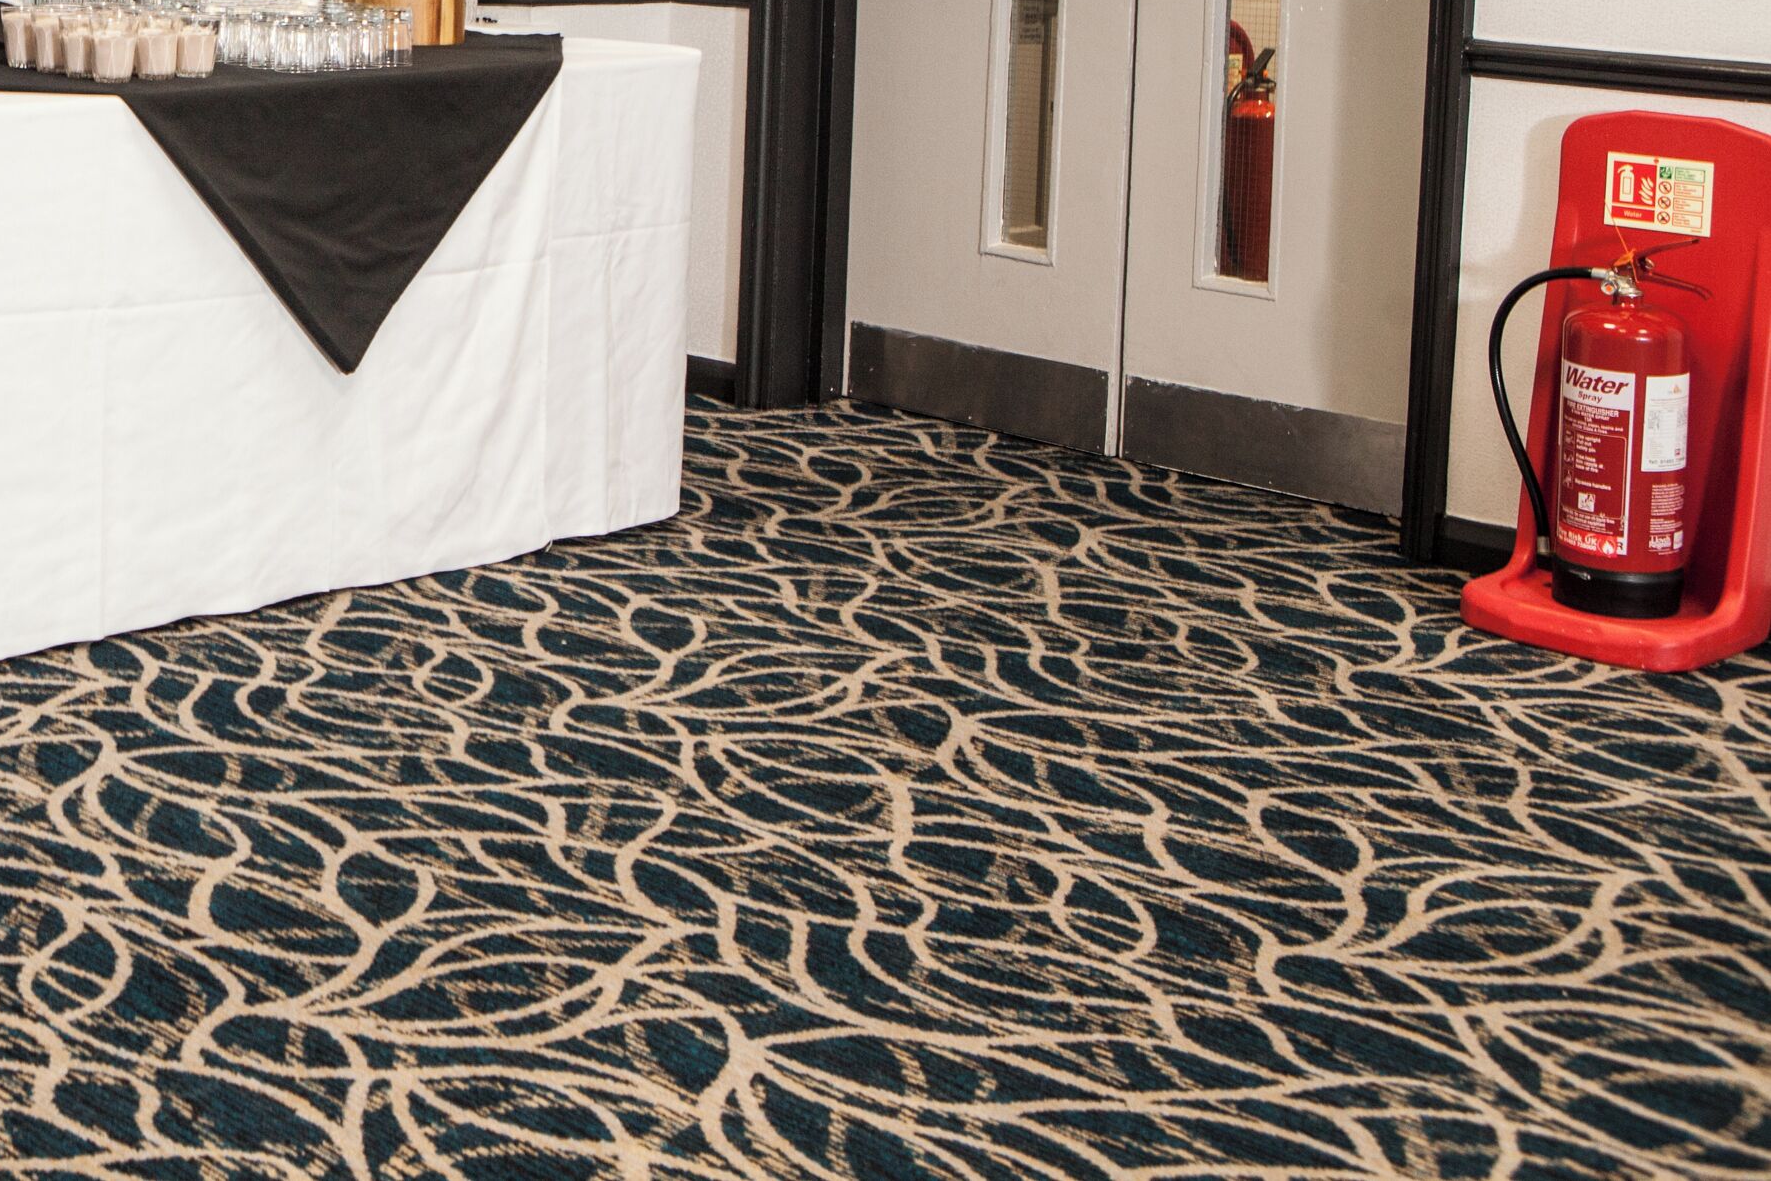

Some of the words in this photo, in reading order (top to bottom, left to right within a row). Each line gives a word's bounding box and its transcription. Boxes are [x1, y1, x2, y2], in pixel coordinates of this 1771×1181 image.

[1623, 210, 1643, 218] Water
[1565, 365, 1630, 396] Water
[1577, 391, 1603, 404] Spray
[1577, 402, 1620, 418] EXTINGUISHER
[1584, 534, 1598, 546] UK
